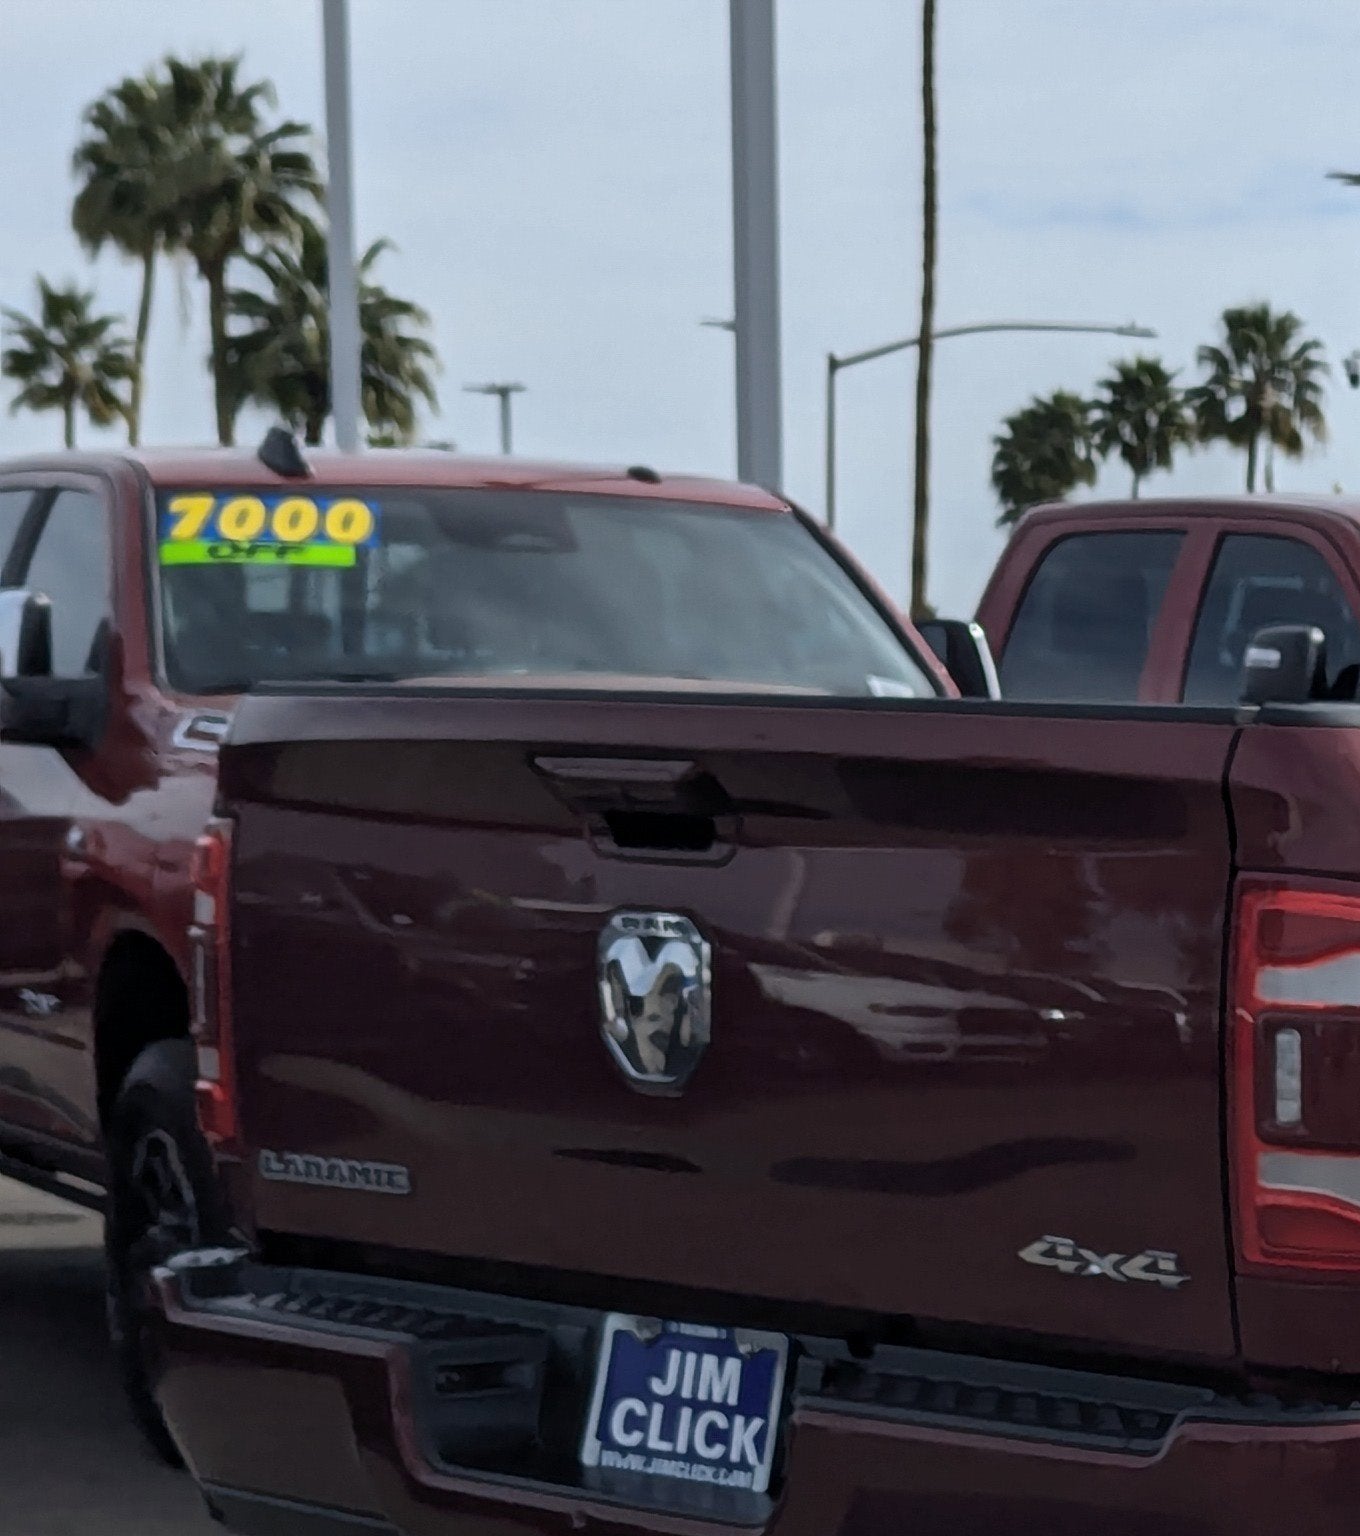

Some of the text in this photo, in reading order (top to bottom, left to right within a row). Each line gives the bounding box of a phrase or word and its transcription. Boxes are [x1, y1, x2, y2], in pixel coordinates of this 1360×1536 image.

[167, 492, 373, 544] 7000
[650, 1348, 742, 1406] JIM
[611, 1397, 766, 1467] CLICK
